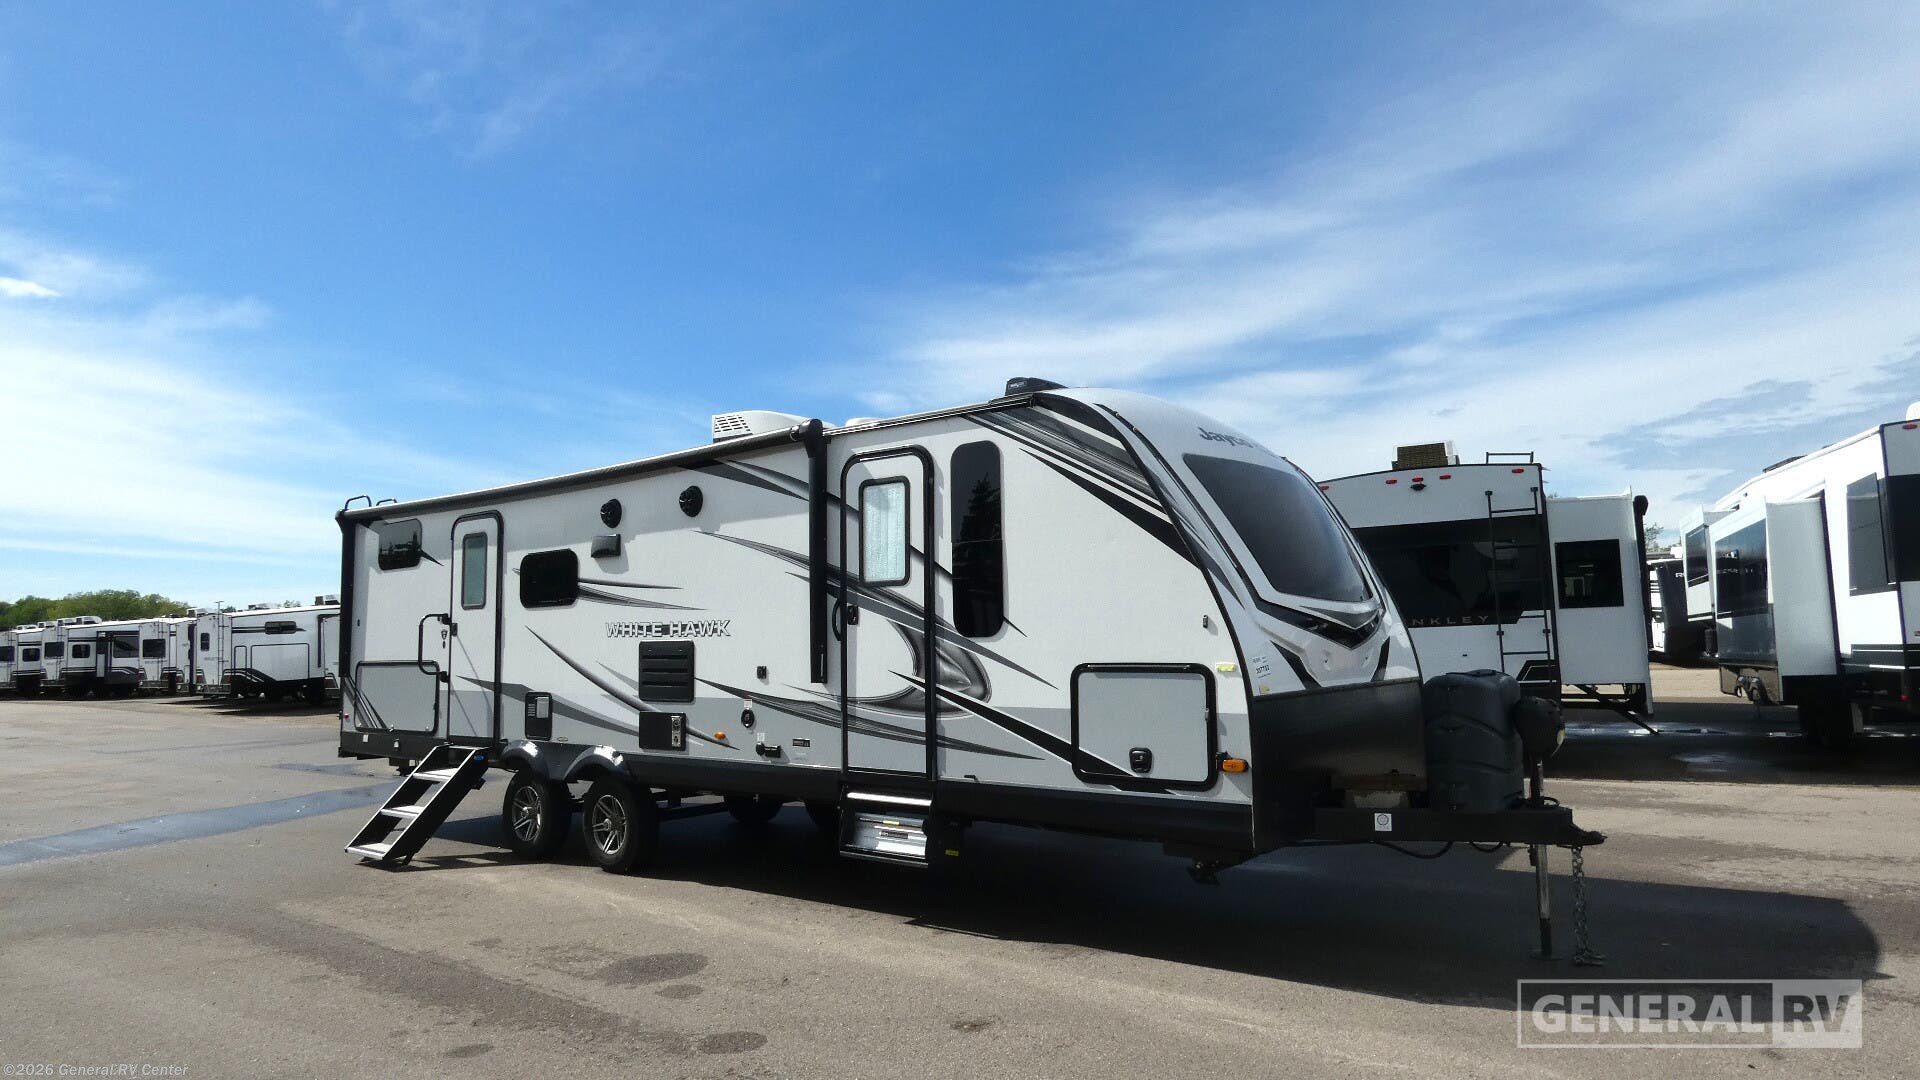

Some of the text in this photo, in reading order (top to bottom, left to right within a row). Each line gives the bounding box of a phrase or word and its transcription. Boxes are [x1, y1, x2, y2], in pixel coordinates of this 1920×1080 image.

[1411, 615, 1489, 626] NKLEY
[605, 620, 732, 638] WHITE HAWK
